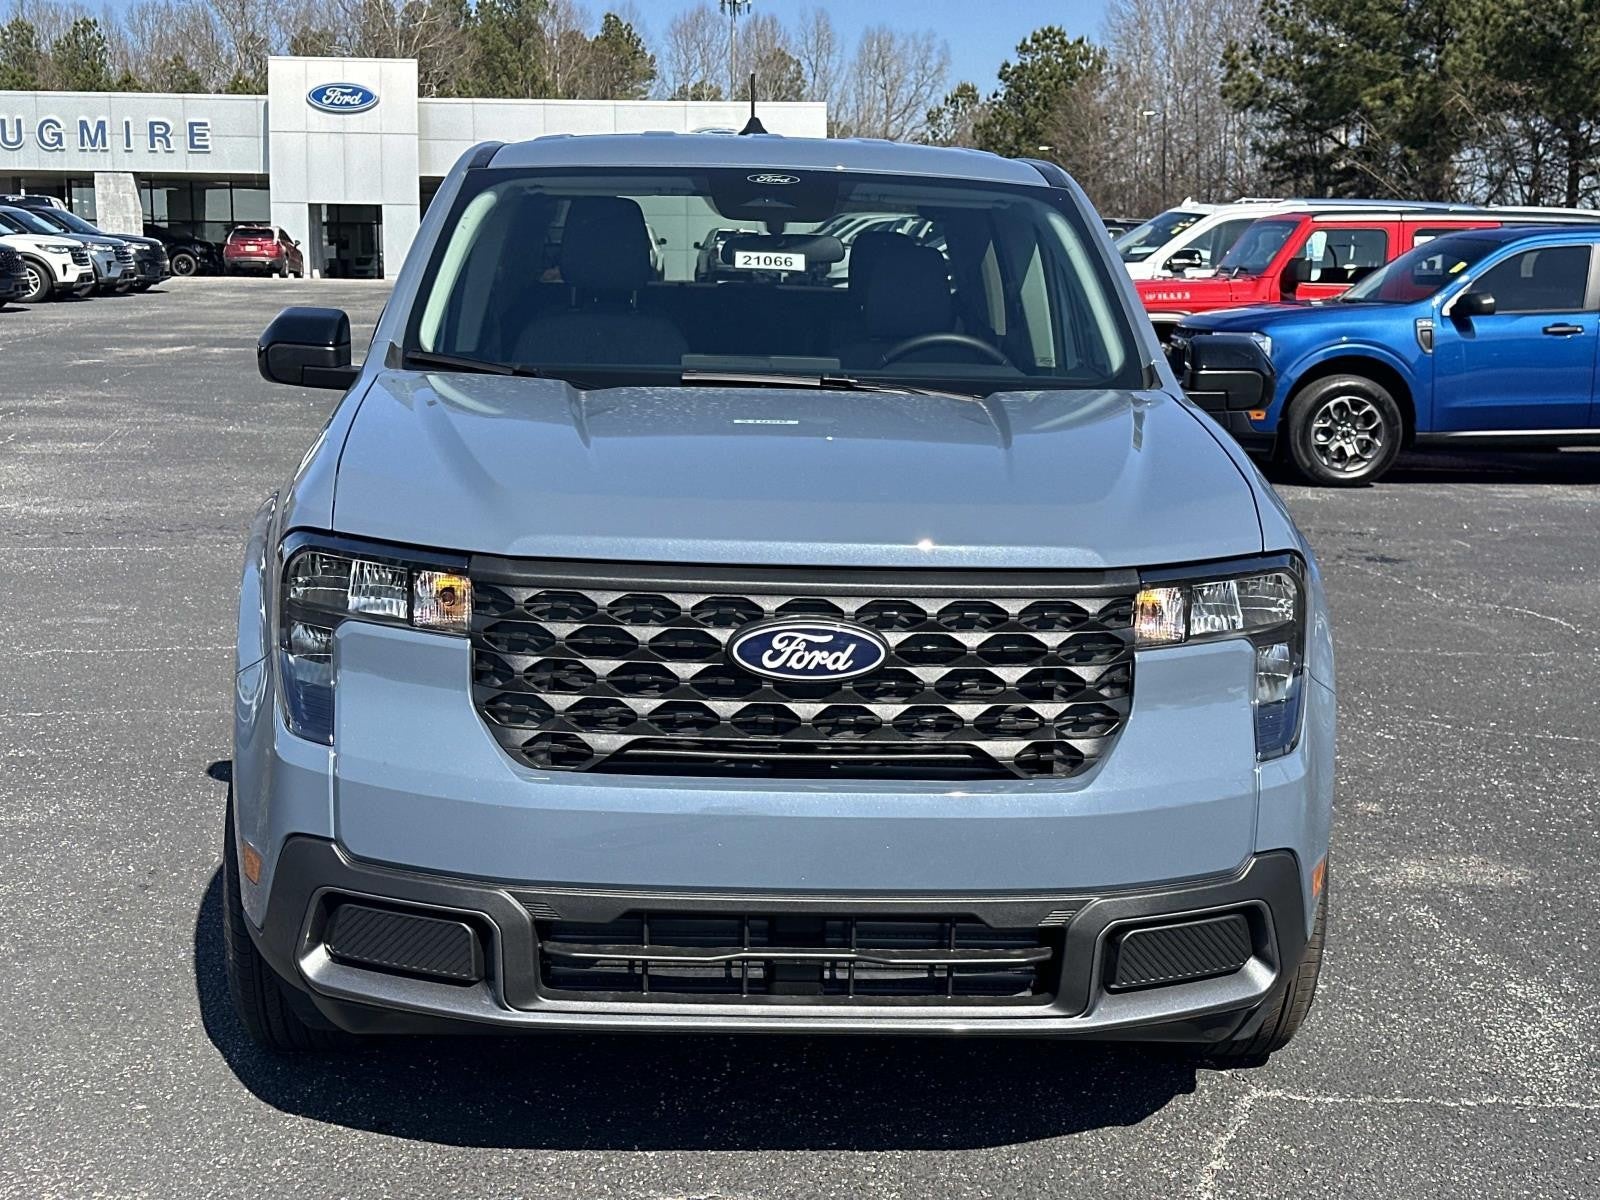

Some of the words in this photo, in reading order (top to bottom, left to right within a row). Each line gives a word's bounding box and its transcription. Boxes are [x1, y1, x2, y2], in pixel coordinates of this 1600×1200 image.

[322, 87, 363, 105] Ford
[0, 117, 210, 153] UGMIRE
[743, 255, 793, 267] 21066
[762, 632, 857, 671] Ford
